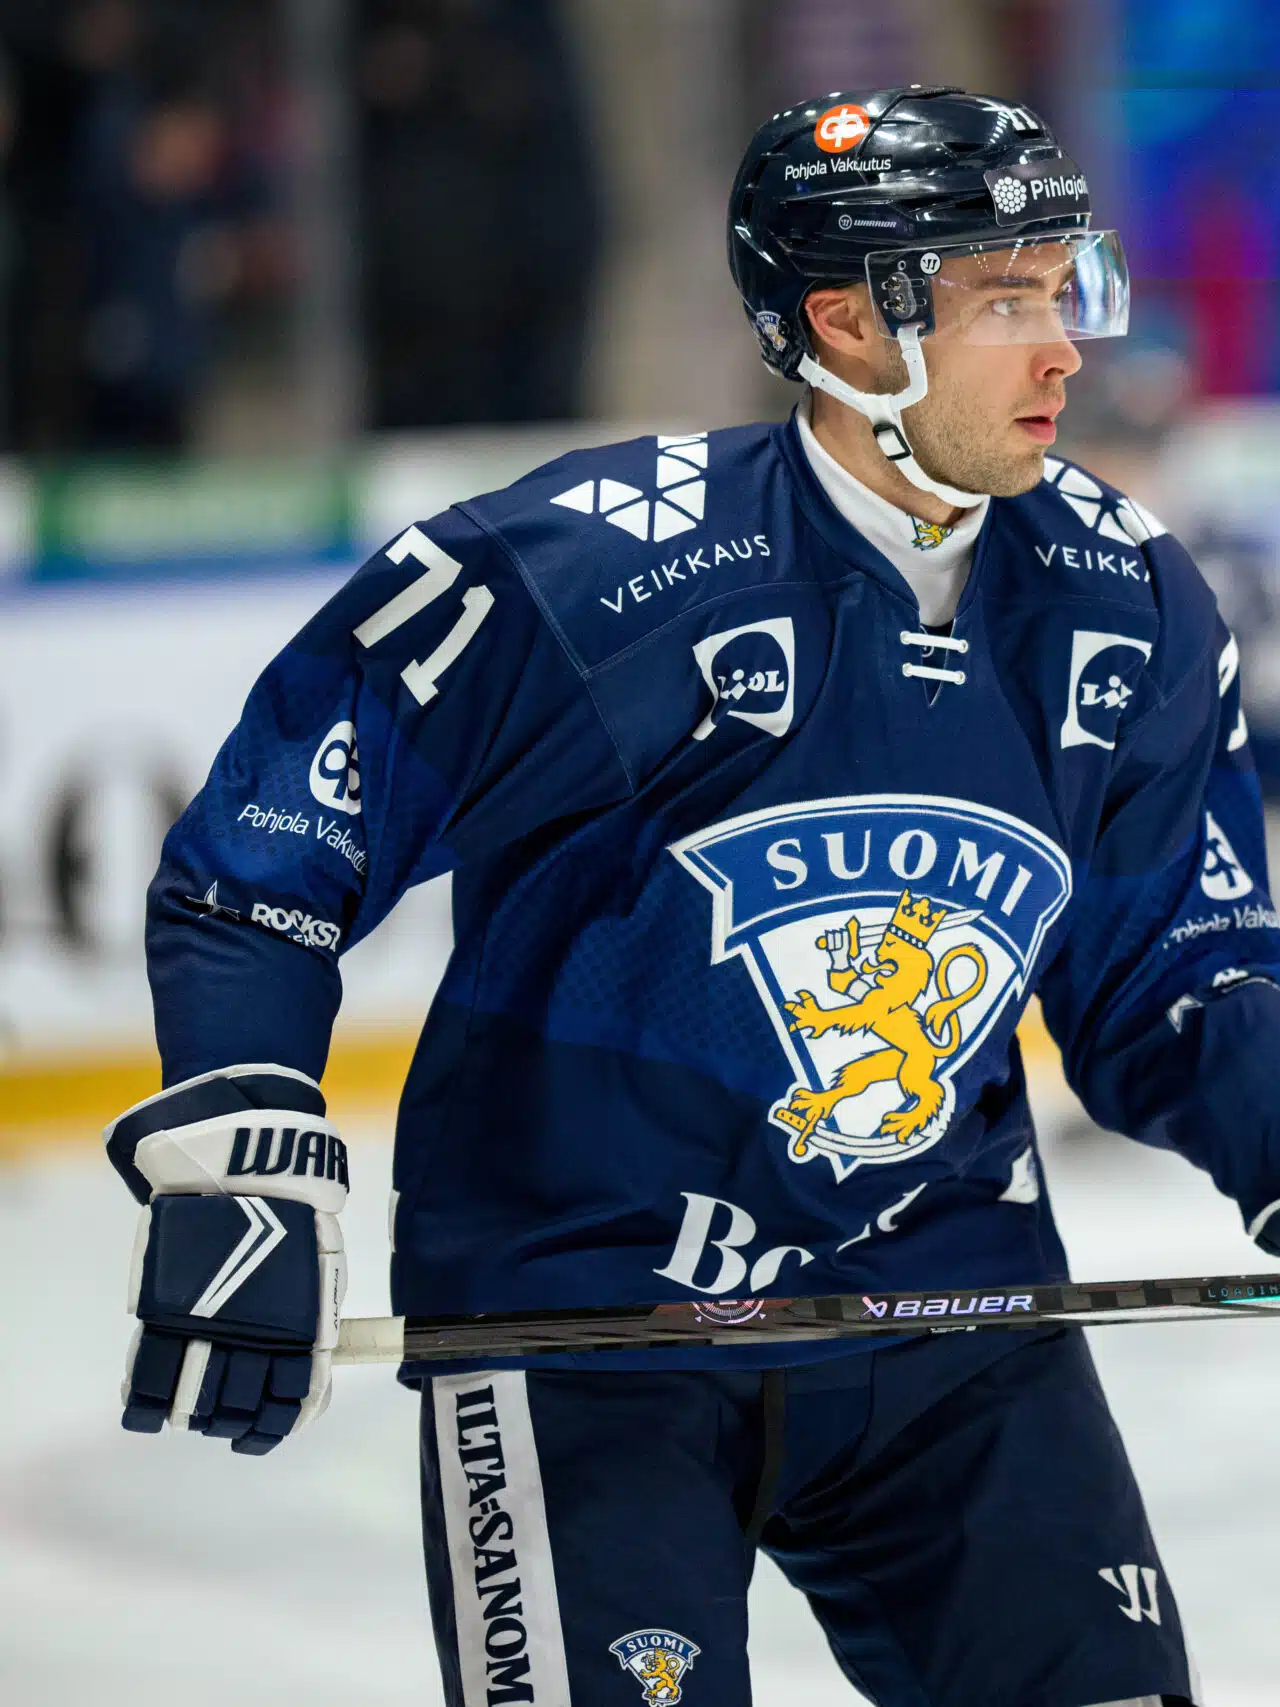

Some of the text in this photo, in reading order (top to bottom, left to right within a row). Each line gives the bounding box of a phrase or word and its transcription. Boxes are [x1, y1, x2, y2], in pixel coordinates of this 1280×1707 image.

[785, 156, 892, 181] Pohjola Vakuutus
[854, 219, 897, 229] WARRIOR
[600, 534, 772, 614] VEIKKAUS
[353, 525, 496, 706] 71
[237, 803, 367, 876] Pohjola Vakuutu
[765, 828, 1032, 917] SUOMI
[892, 1295, 1034, 1318] BAUER
[626, 1634, 687, 1655] SUOMI
